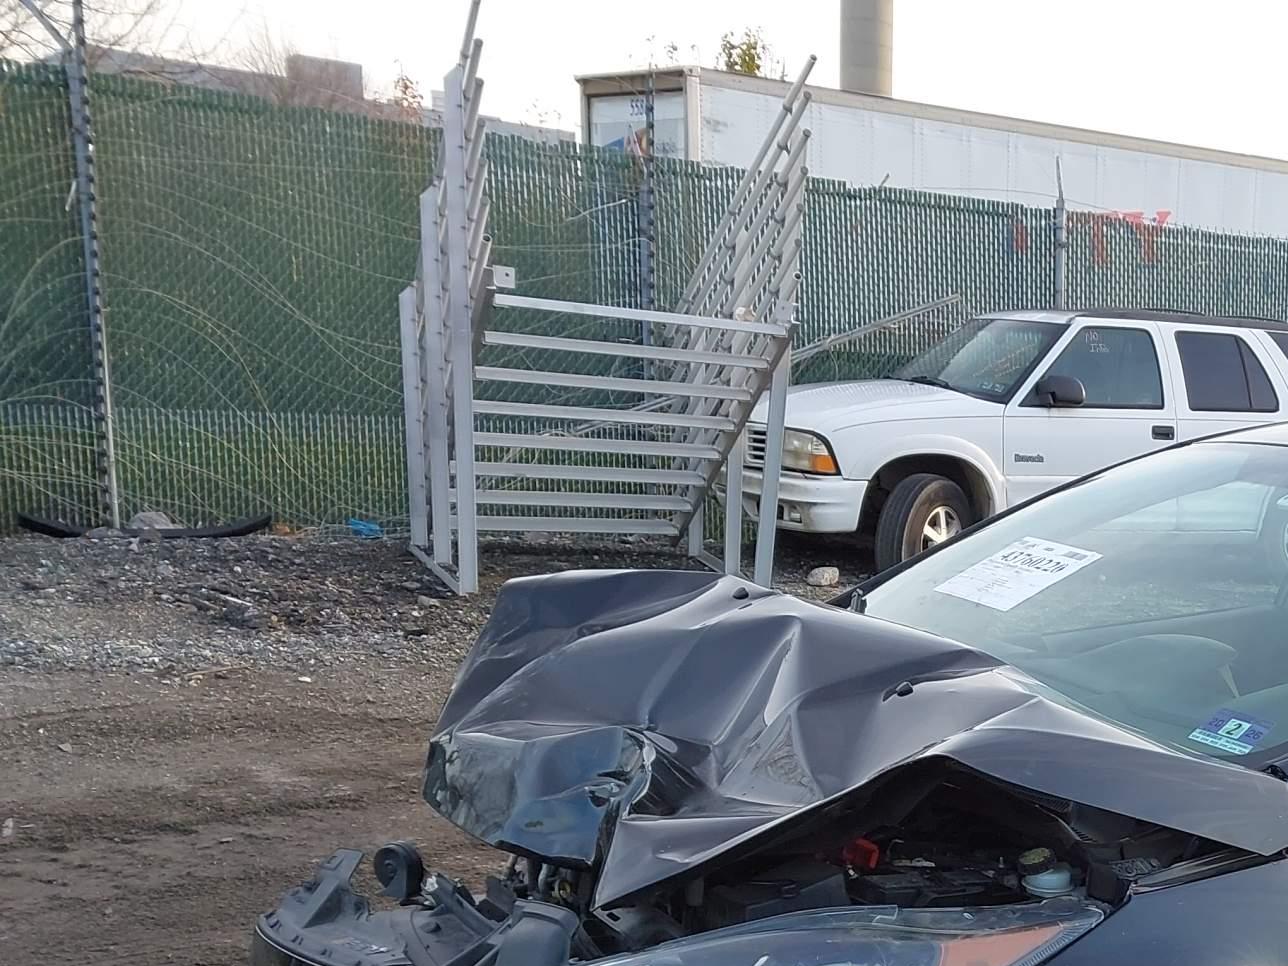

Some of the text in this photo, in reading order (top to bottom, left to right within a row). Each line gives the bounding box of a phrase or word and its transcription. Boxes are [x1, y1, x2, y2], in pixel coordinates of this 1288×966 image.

[1000, 549, 1071, 574] 43760220
[1225, 722, 1243, 736] 2
[1244, 729, 1264, 741] 26
